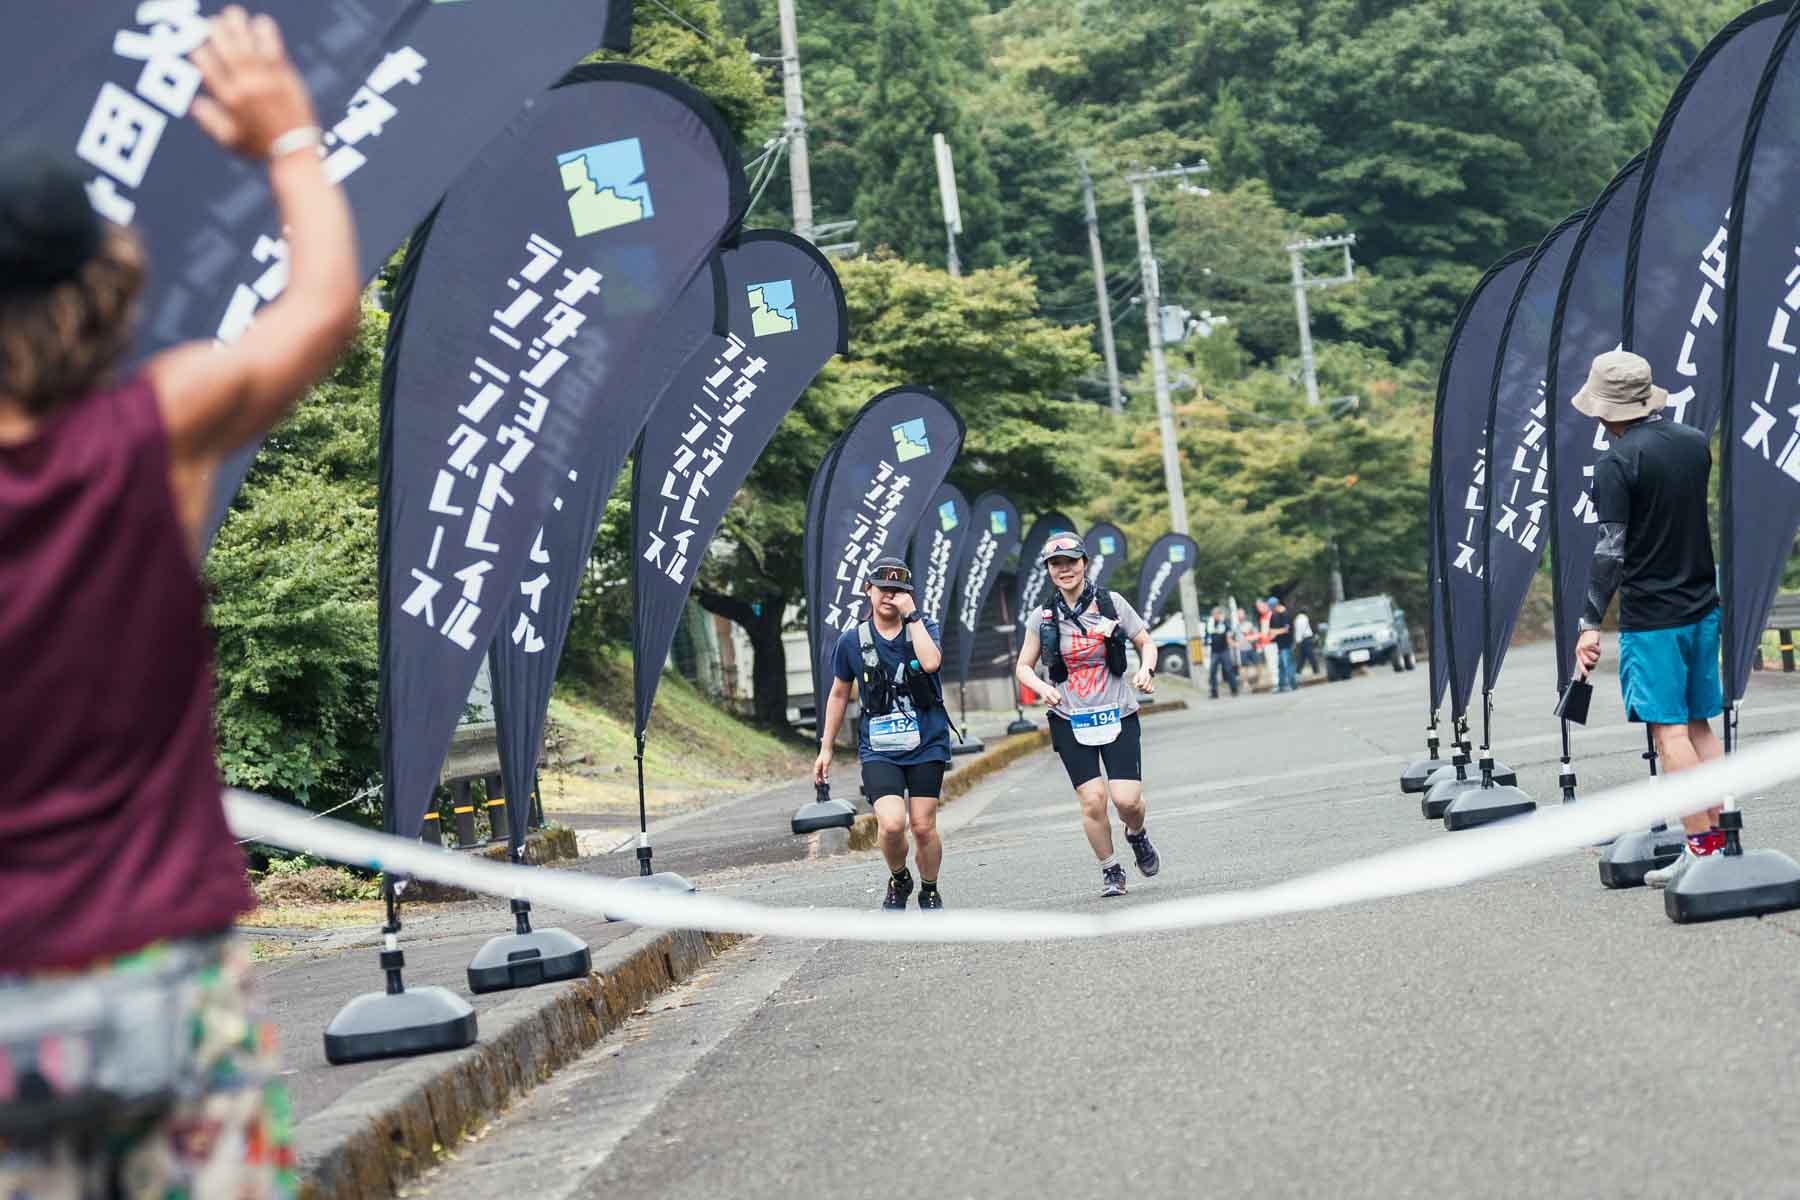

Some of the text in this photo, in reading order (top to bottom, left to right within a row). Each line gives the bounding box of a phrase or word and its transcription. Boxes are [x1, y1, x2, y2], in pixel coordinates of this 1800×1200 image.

[402, 233, 562, 627] ランニングレース
[643, 332, 746, 569] ランニングレース
[825, 460, 894, 630] ランニングレース
[889, 719, 915, 732] 152
[1090, 710, 1116, 726] 194
